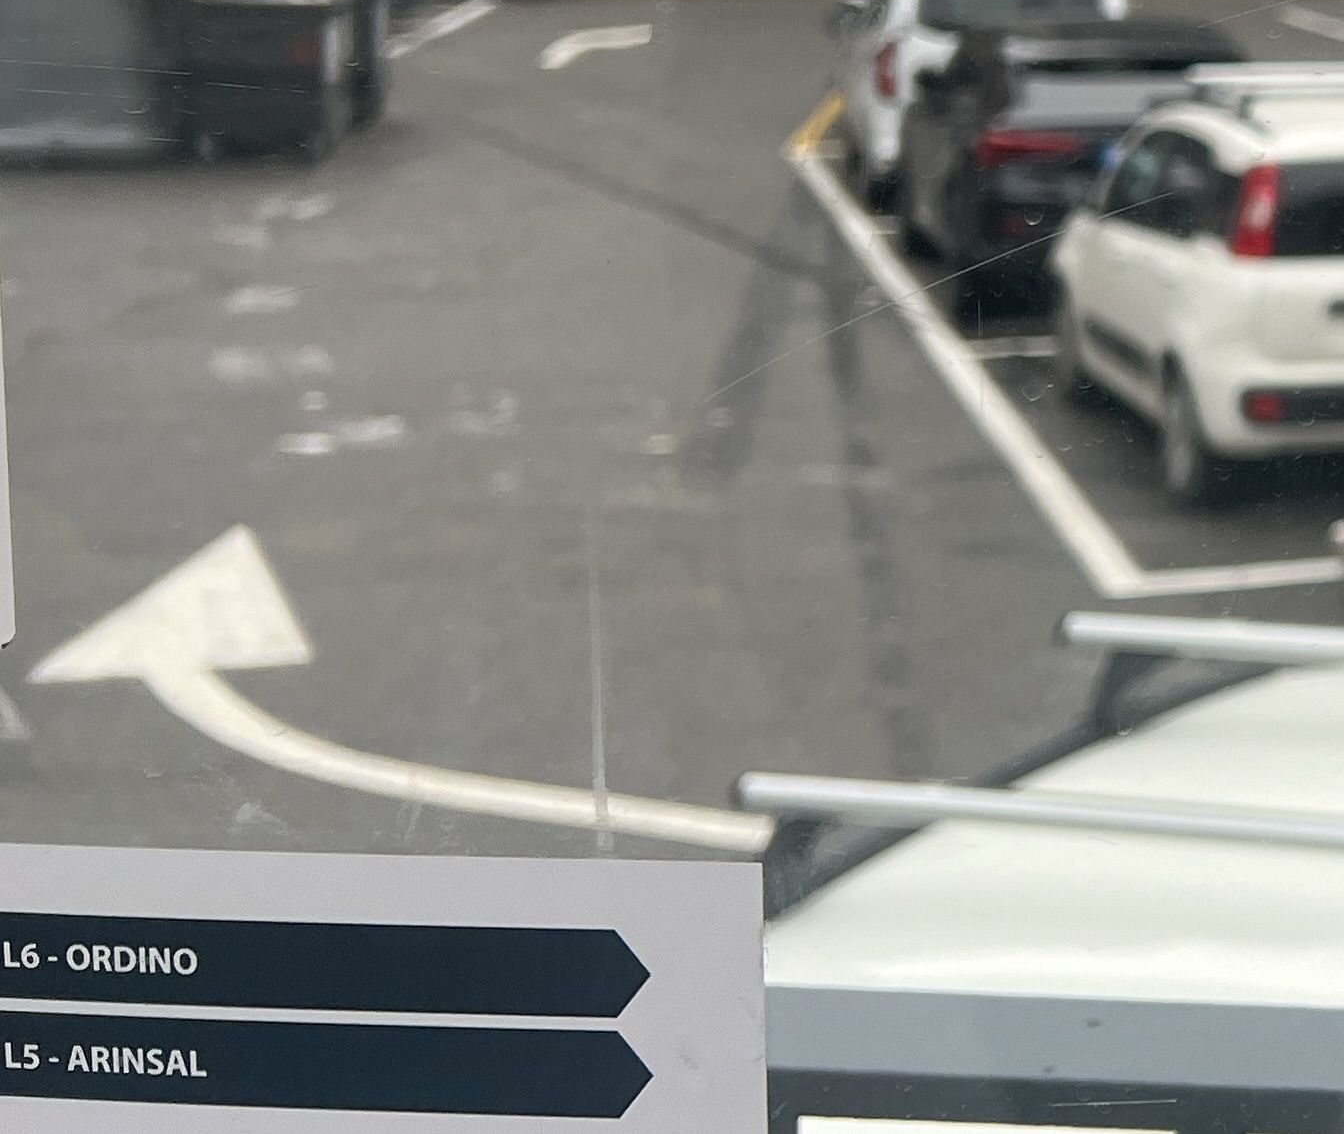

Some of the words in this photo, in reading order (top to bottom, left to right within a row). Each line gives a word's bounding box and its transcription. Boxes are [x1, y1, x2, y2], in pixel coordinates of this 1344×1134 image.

[3, 941, 40, 969] L6
[66, 944, 198, 976] ORDINO
[4, 1042, 40, 1070] L5
[67, 1045, 208, 1078] ARINSAL
